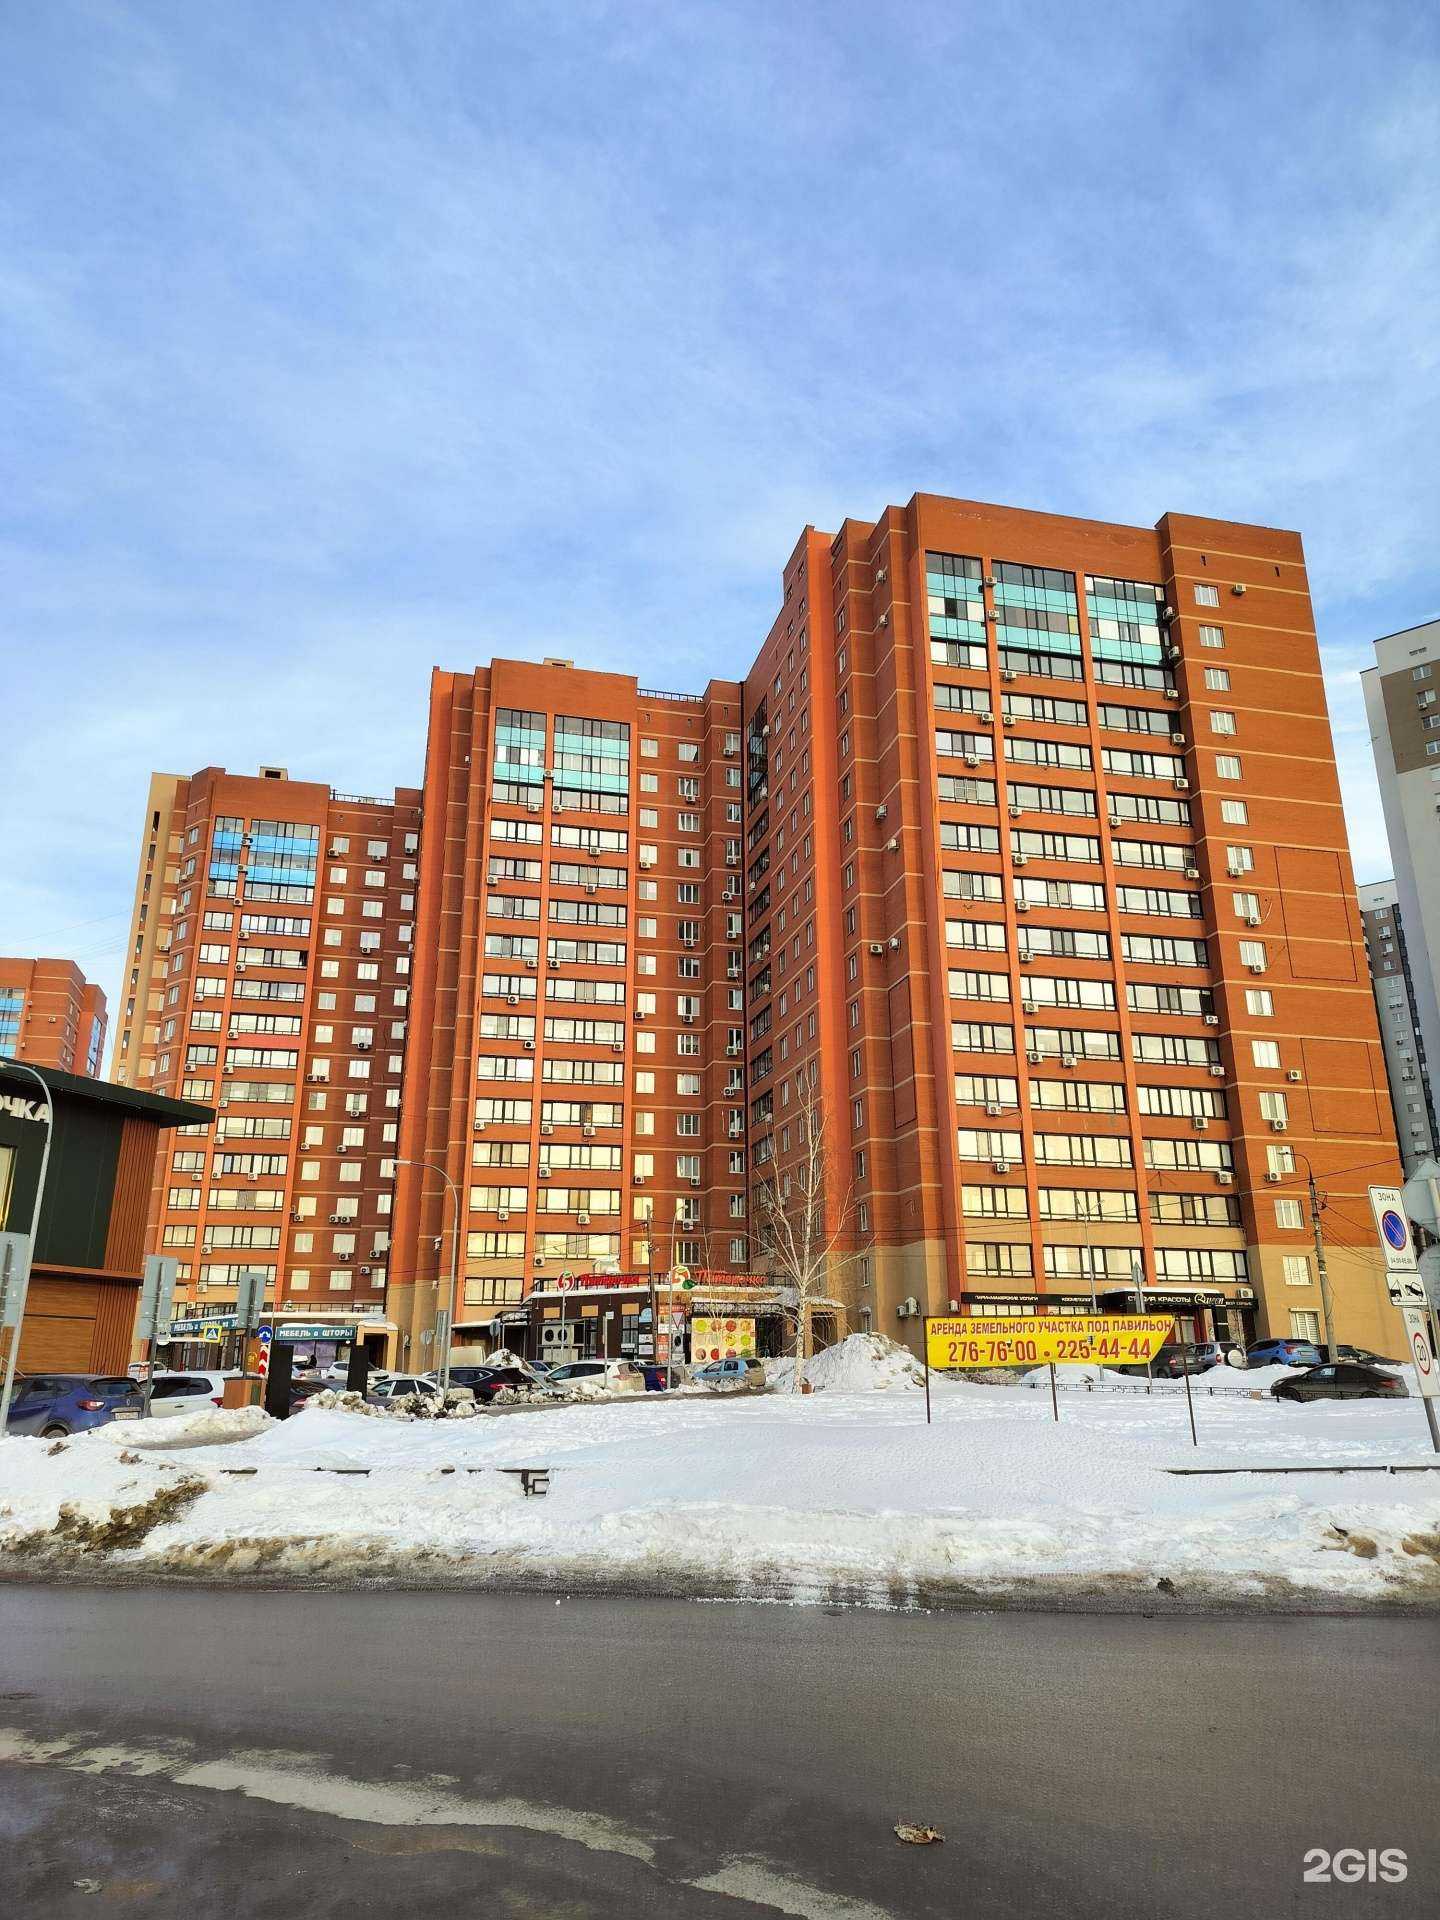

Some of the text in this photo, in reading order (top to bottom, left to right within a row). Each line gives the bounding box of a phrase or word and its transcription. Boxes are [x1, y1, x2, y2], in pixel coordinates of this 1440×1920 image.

[0, 1094, 50, 1123] ЧКА
[1377, 1192, 1396, 1202] ЗОНА
[279, 1330, 311, 1338] МЕБЕЛЬ
[322, 1329, 353, 1337] ШТОРЫ
[931, 1319, 1171, 1336] АРЕНДА ЗЕМЕЛЬНОГО УЧАСТКА ПОД ПАВИЛЬОН
[948, 1337, 1152, 1362] 276-76-00 225-44-44
